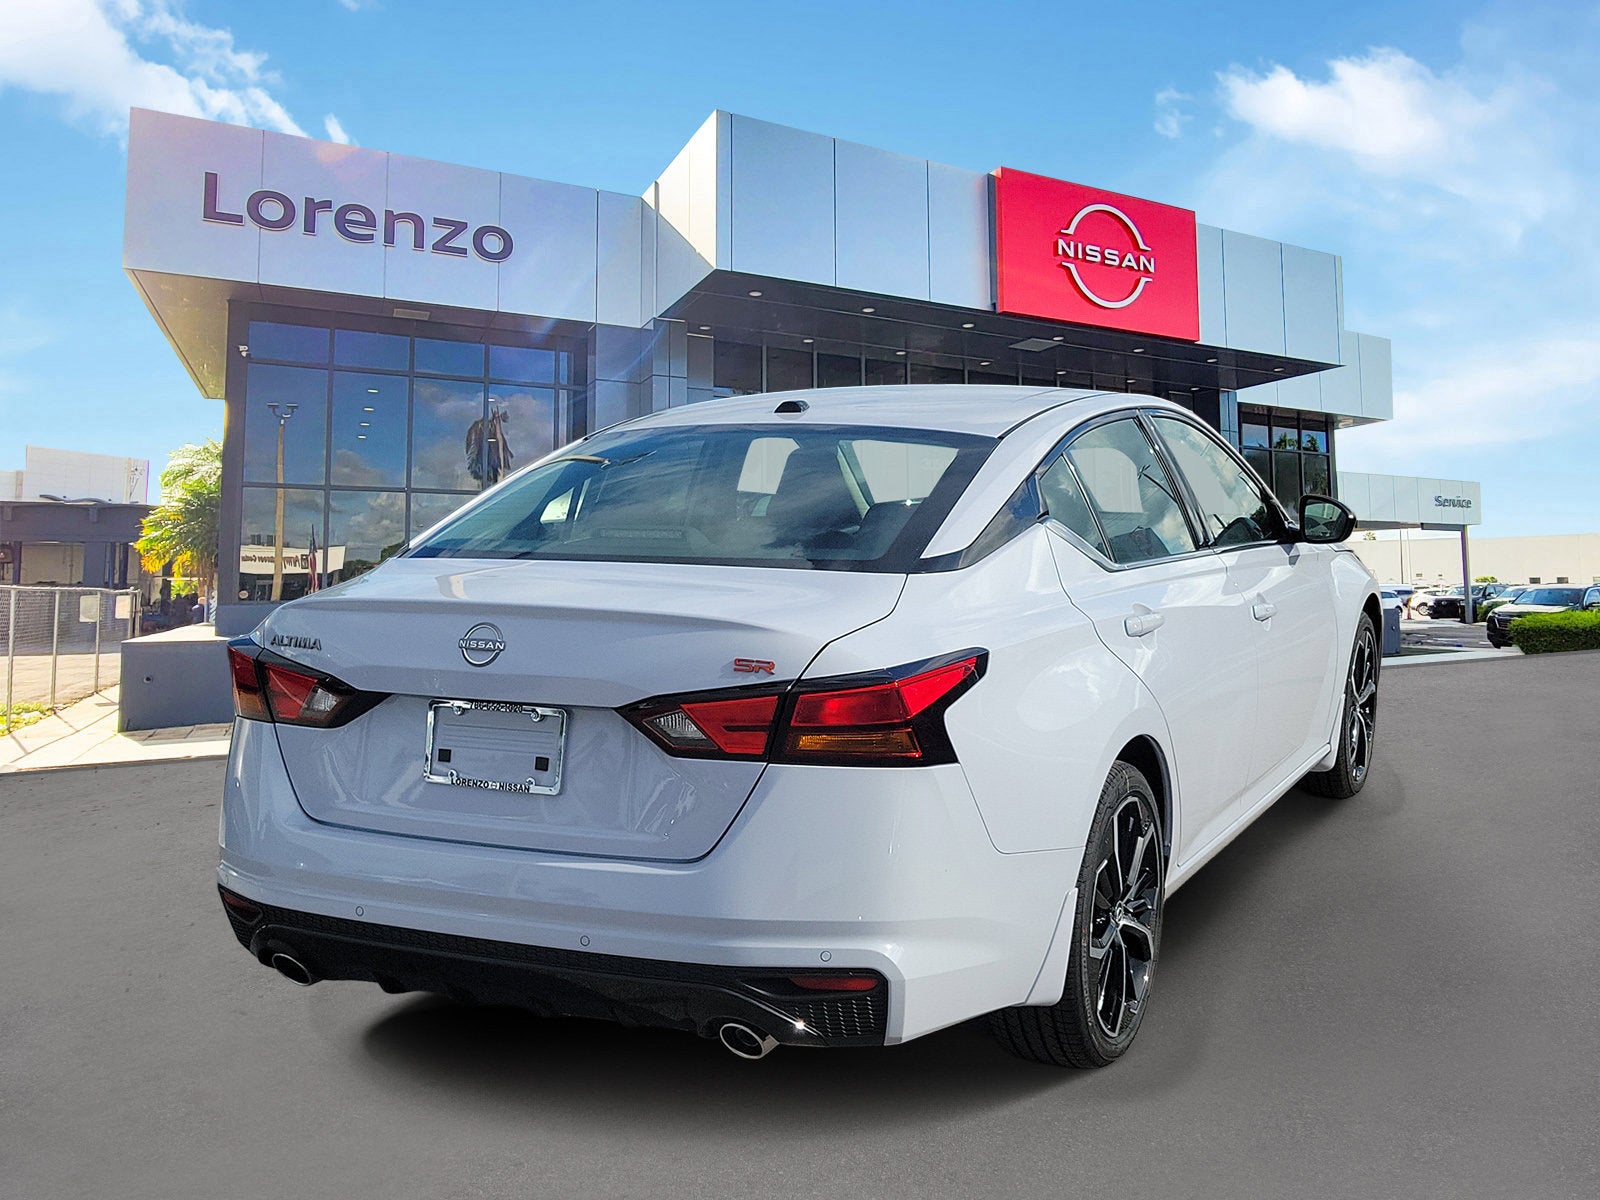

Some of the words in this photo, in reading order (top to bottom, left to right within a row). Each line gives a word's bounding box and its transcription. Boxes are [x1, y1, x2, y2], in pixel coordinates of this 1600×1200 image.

[202, 170, 515, 263] Lorenzo
[1057, 238, 1156, 273] NISSAN
[1434, 495, 1472, 508] Service
[270, 634, 322, 651] ALTIMA
[459, 640, 505, 650] NISSAN
[733, 658, 776, 675] SR
[451, 777, 490, 789] LORENZO
[499, 782, 530, 793] NISSAN
